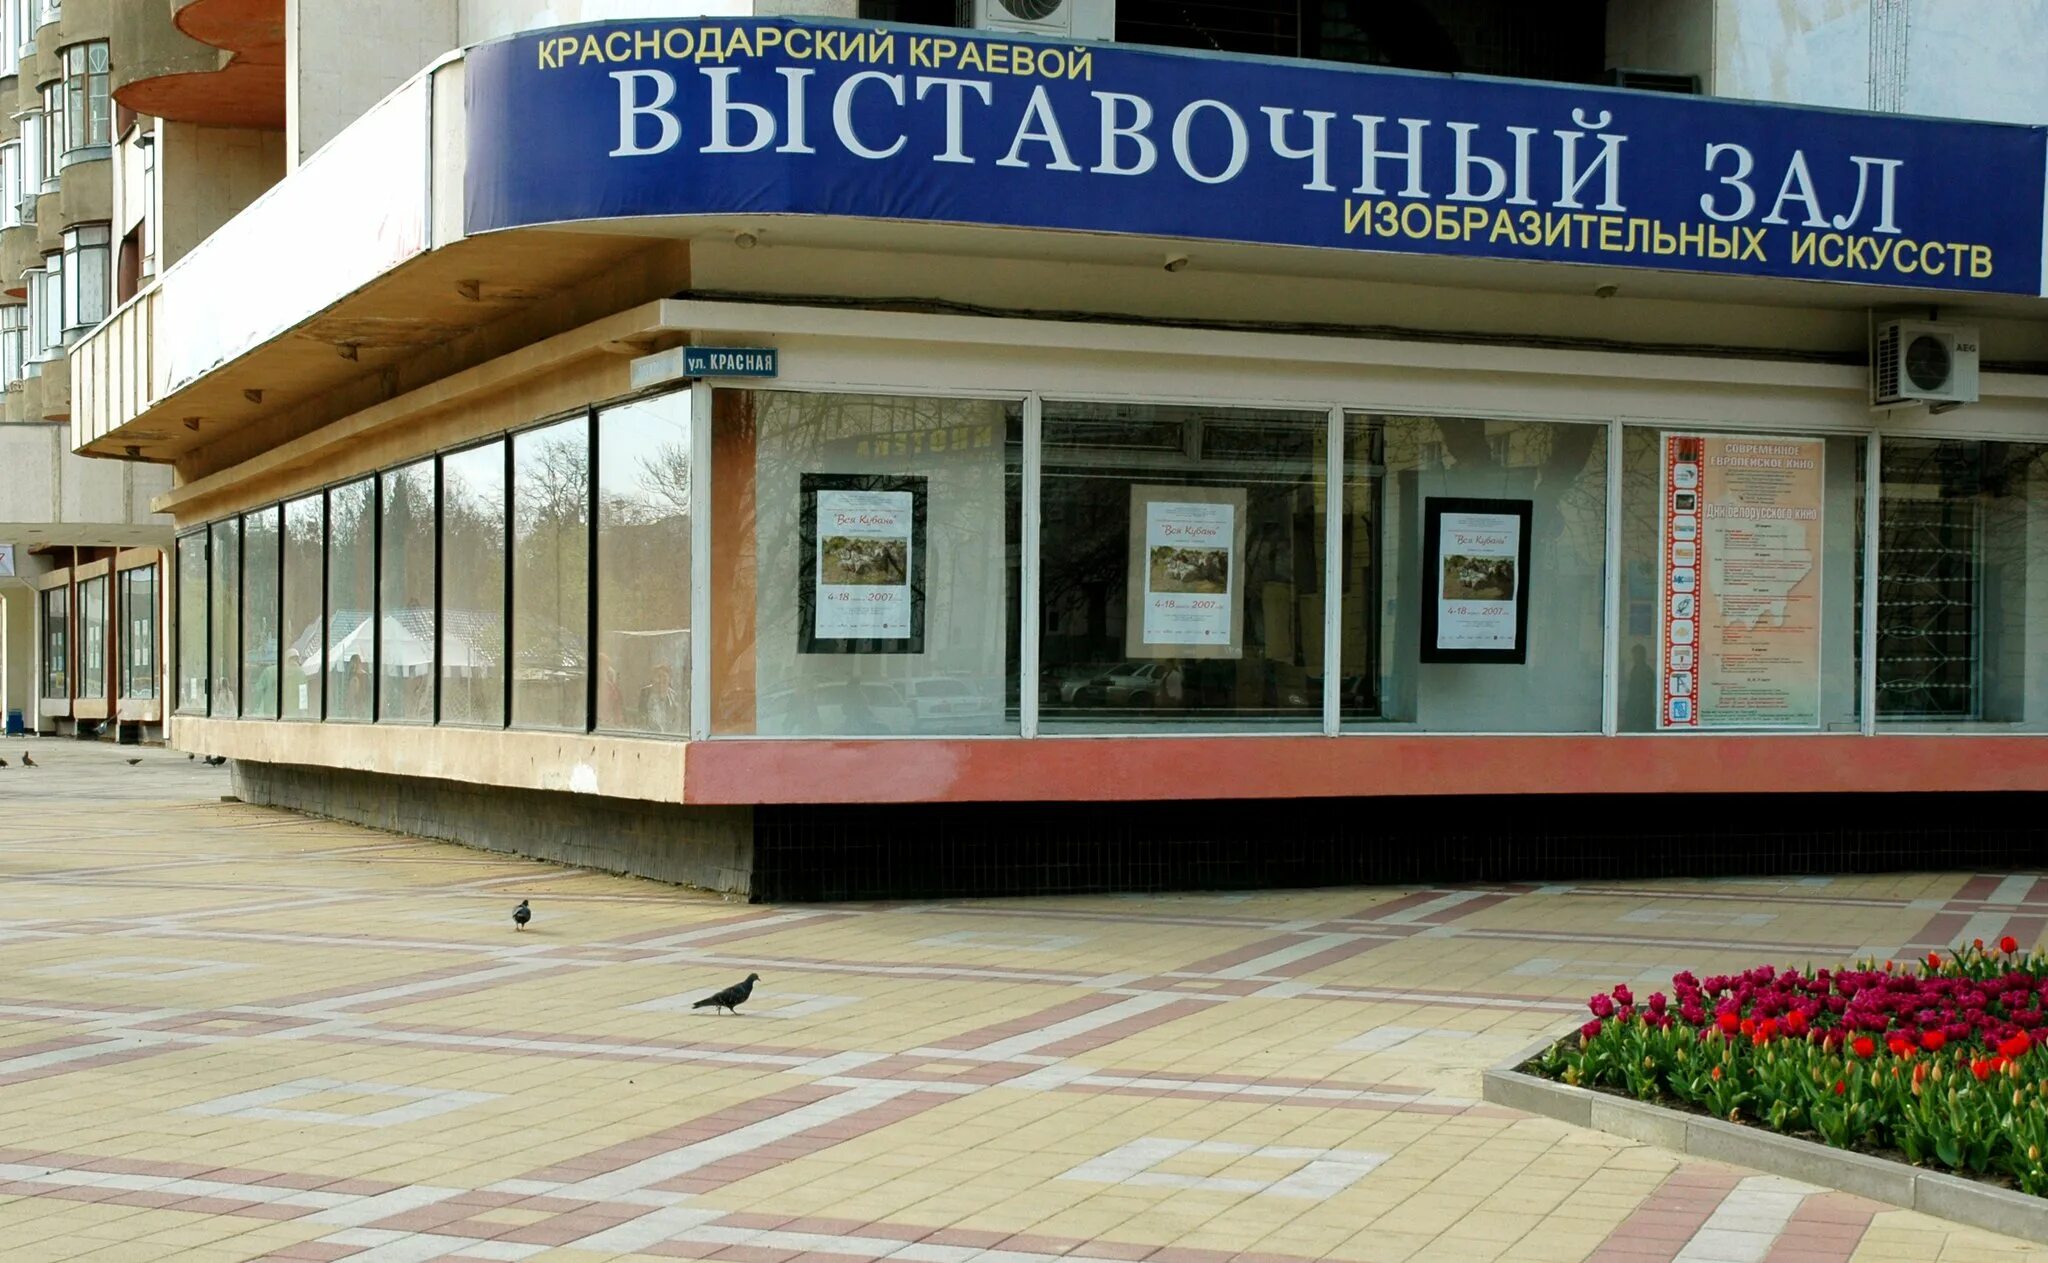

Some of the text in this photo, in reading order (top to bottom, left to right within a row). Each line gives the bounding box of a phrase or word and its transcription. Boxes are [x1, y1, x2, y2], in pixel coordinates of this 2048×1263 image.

[536, 26, 1094, 82] КРАСНОДАРСКИЙ КРАЕВОЙ
[608, 66, 1904, 235] ВЫСТАВОЧНЫЙ ЗАЛ
[1343, 198, 1993, 279] ИЗОБРАЗИТЕЛЬНЫХ ИСКУССТВ
[1956, 343, 1976, 352] AEG
[688, 353, 772, 371] ул. КРАСНАЯ
[1725, 443, 1800, 456] СОВРЕМЕННОЕ
[867, 592, 894, 601] 2007
[1154, 600, 1175, 609] 4-18
[1191, 600, 1216, 609] 2007
[1447, 606, 1468, 615] 4-18
[1481, 607, 1504, 616] 2007
